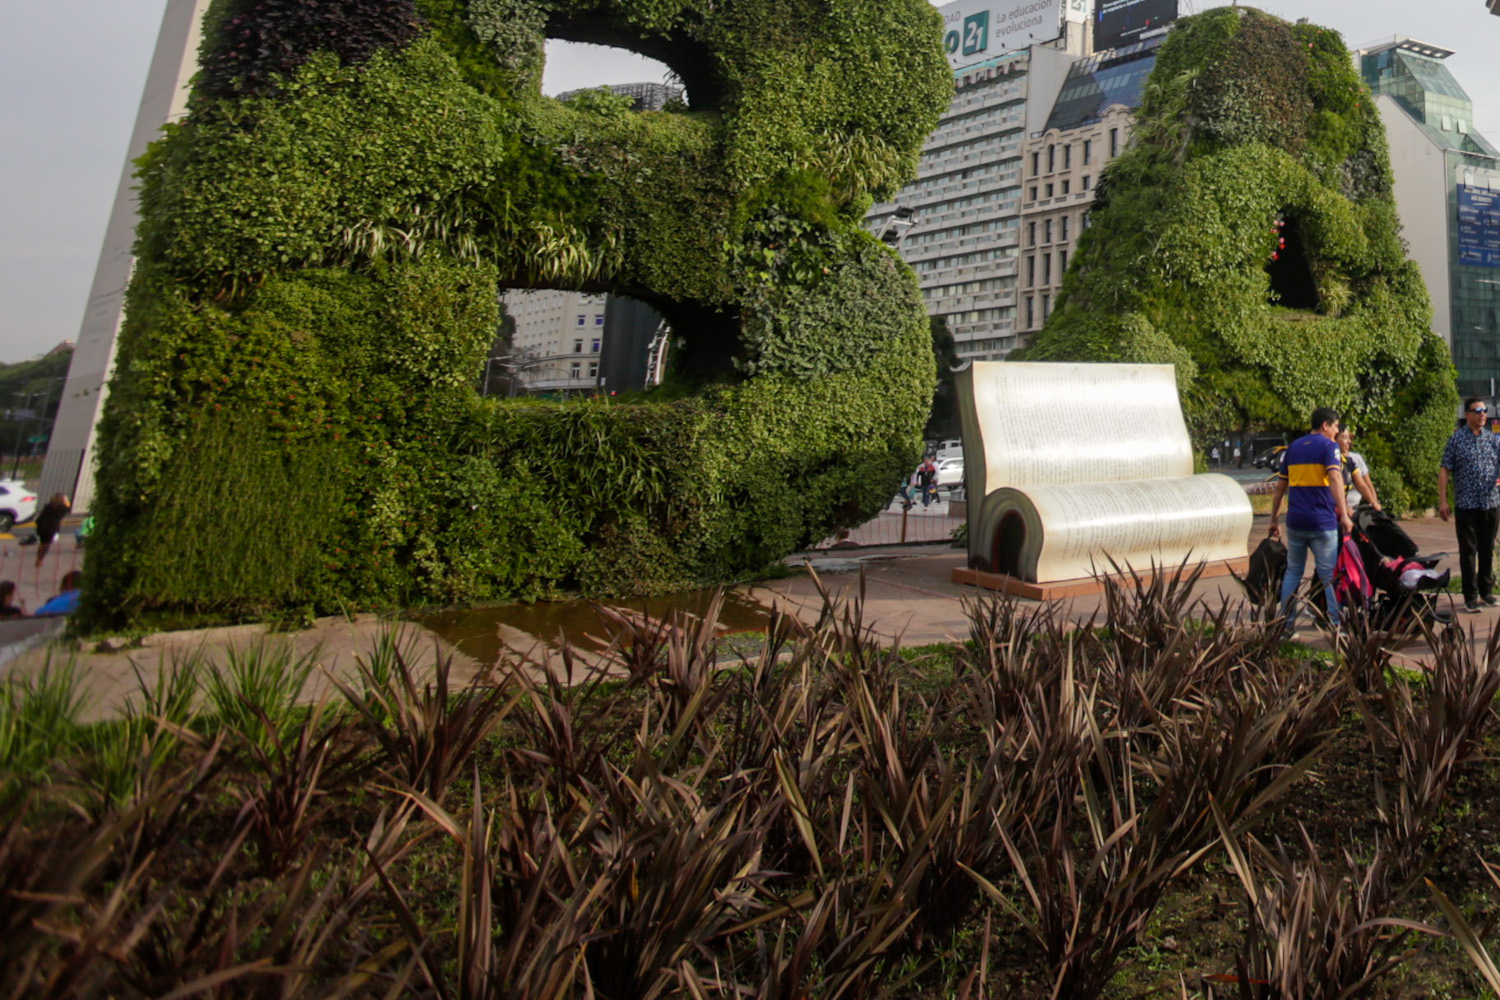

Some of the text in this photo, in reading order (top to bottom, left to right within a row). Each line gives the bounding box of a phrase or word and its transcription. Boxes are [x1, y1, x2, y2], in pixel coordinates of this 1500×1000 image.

[996, 12, 1007, 24] La
[996, 14, 1043, 38] evoluciona
[964, 21, 985, 52] 21
